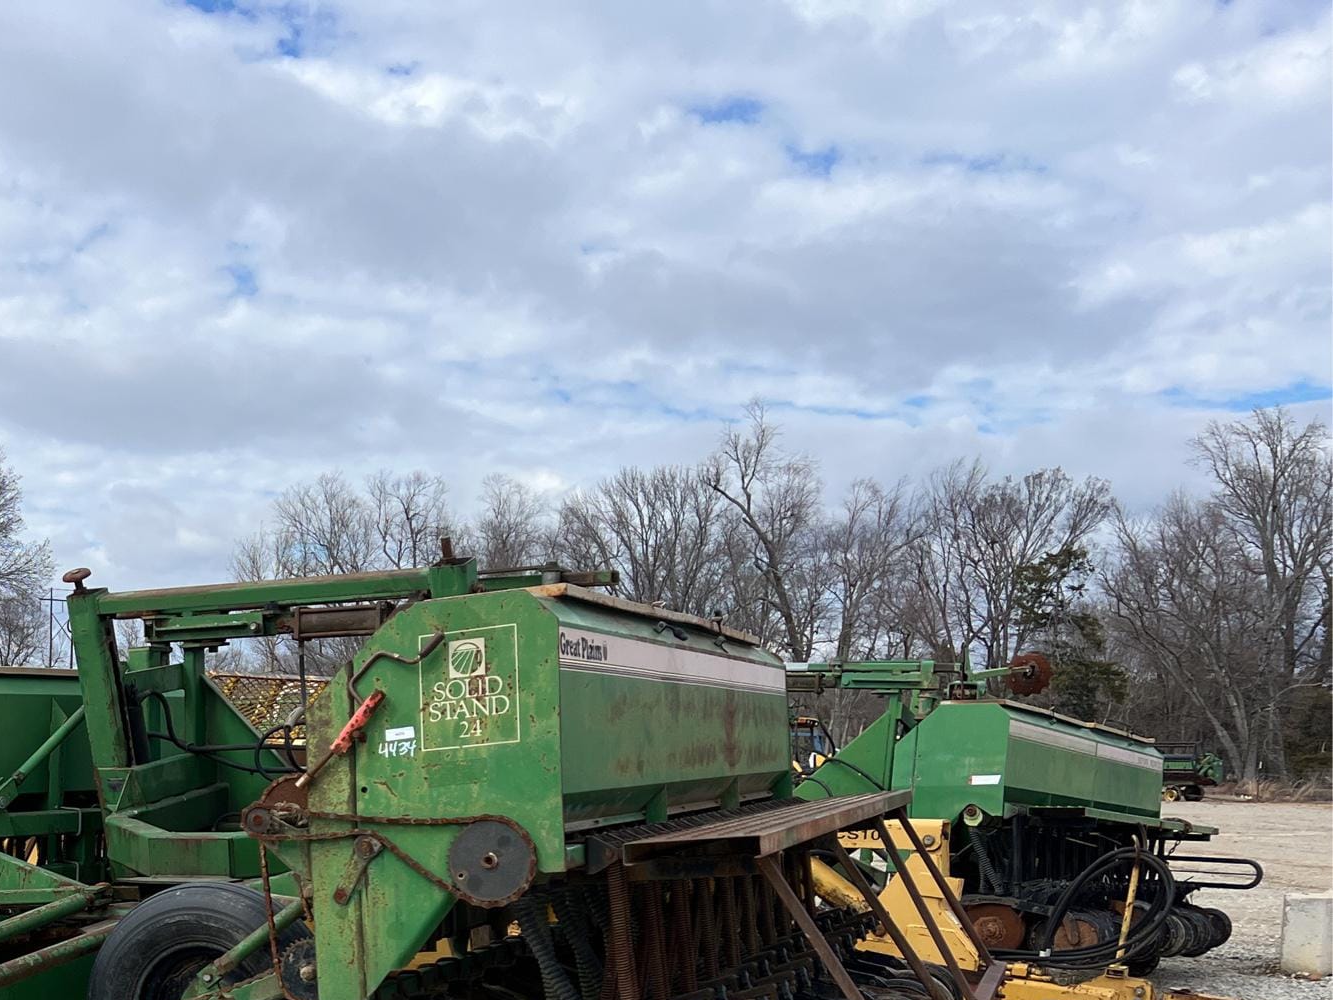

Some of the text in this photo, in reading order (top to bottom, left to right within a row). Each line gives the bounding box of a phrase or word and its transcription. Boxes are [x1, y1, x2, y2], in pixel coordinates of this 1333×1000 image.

[560, 632, 603, 661] Great Plains
[433, 675, 503, 702] SOLID
[428, 694, 510, 723] STAND
[459, 720, 482, 738] 24
[378, 740, 417, 758] 4434
